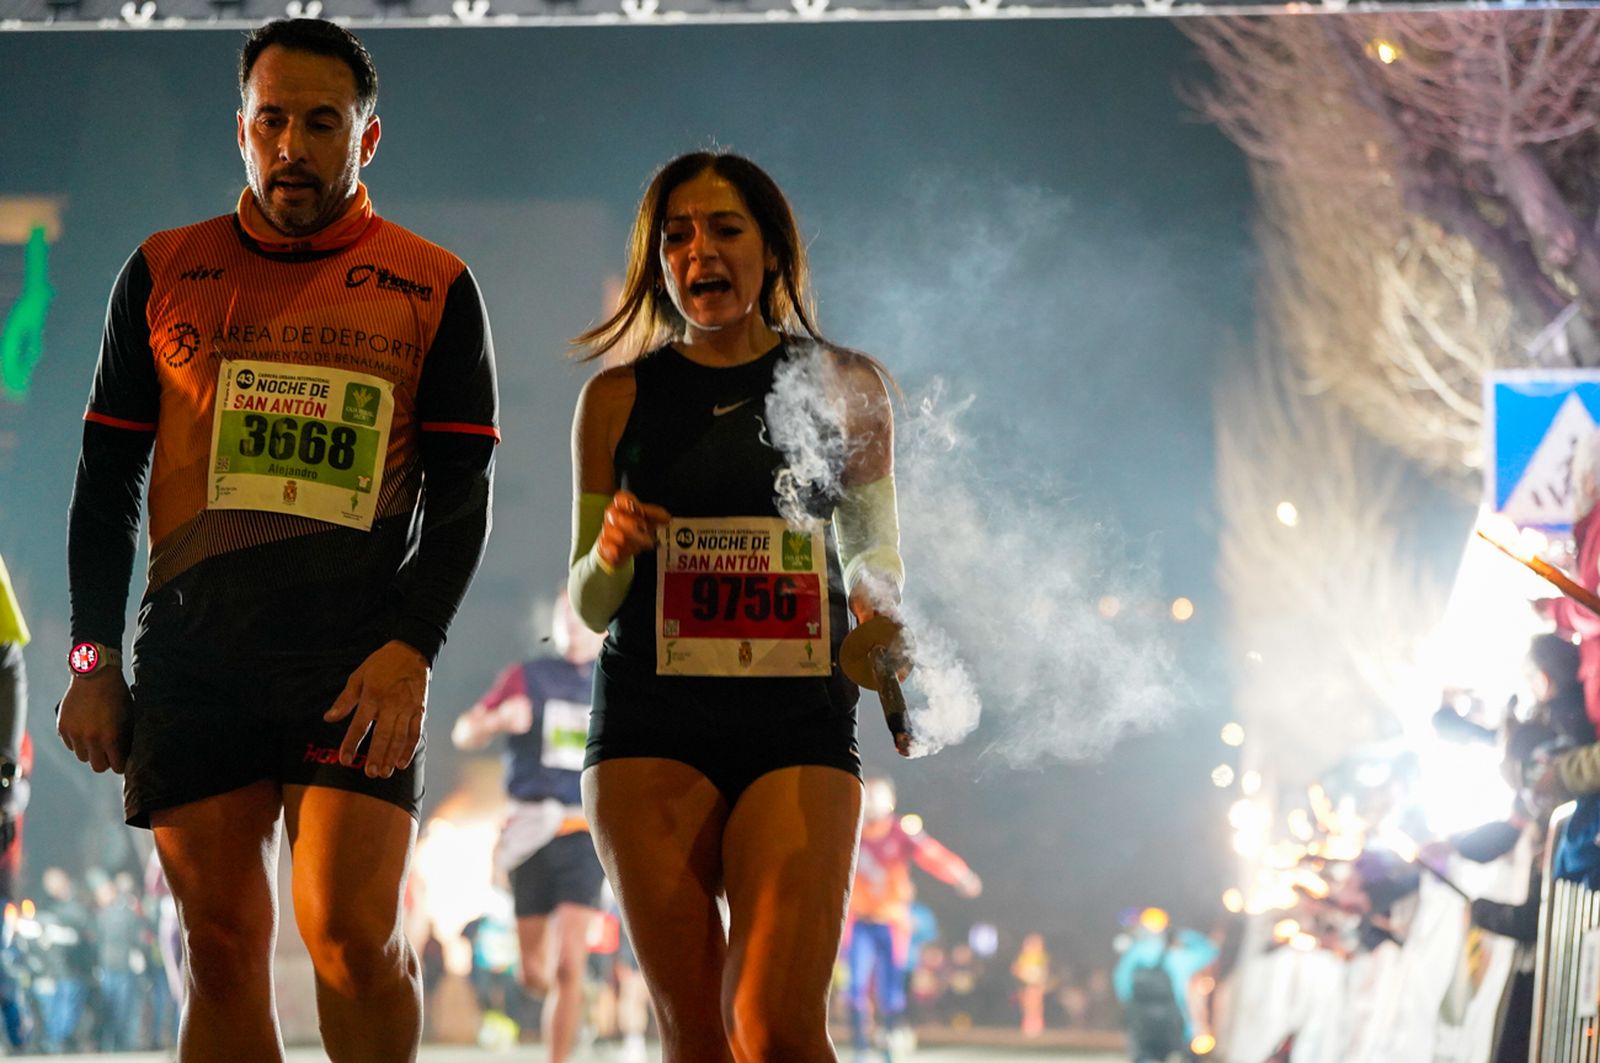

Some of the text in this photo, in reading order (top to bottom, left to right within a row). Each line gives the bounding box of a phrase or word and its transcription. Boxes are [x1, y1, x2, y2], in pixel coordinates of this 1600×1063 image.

[282, 326, 314, 344] DE
[236, 371, 255, 388] 43
[256, 378, 330, 399] NOCHE DE
[233, 394, 327, 418] SAN ANTÓN
[239, 414, 357, 471] 3668
[268, 463, 318, 480] Alejandro
[676, 529, 694, 546] 43
[697, 535, 771, 550] NOCHE DE
[677, 554, 710, 571] SAN
[713, 551, 771, 571] ANTÓN
[692, 576, 797, 622] 9756
